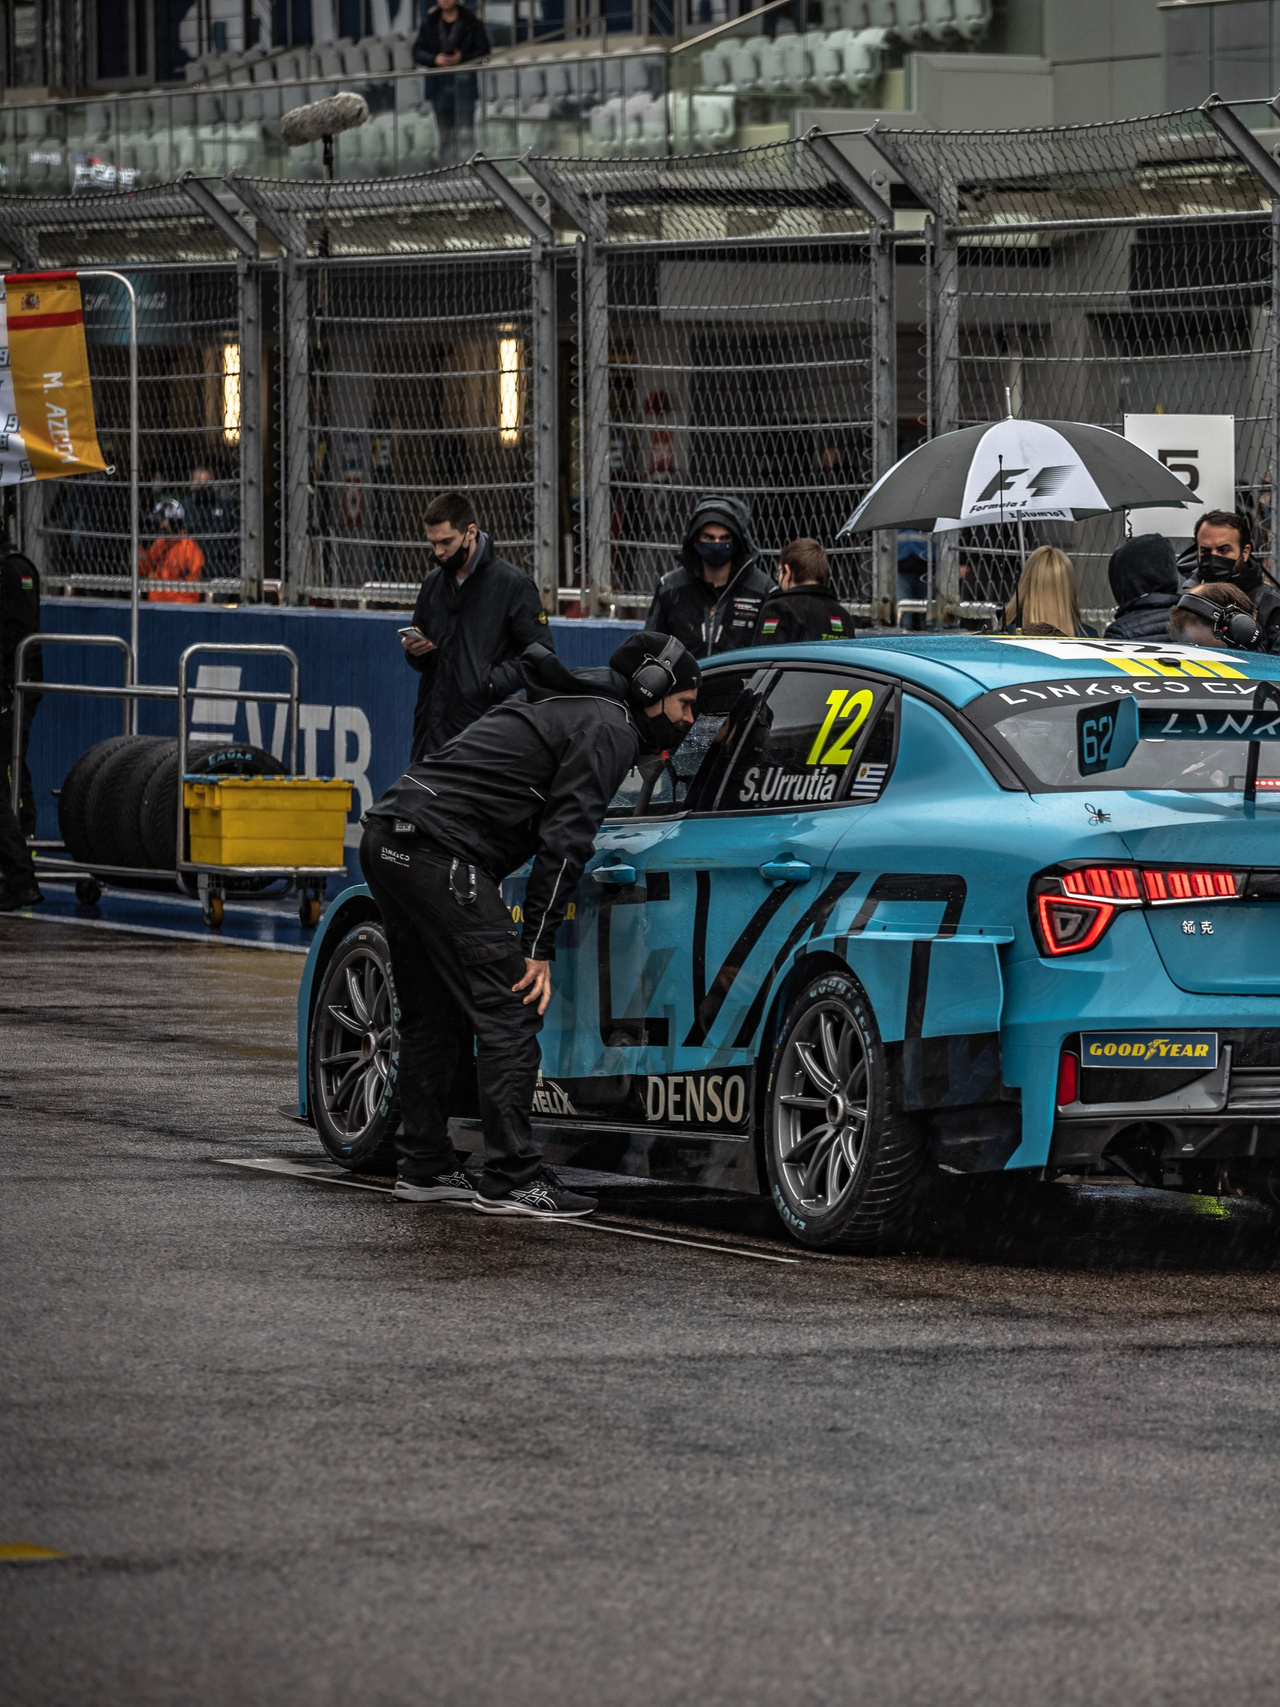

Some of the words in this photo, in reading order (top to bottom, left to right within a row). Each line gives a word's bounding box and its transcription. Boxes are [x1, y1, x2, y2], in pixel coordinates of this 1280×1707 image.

[42, 370, 64, 395] M.
[976, 464, 1079, 503] F1
[969, 501, 1018, 514] Formula
[1060, 642, 1185, 655] 12
[806, 689, 873, 765] 12
[1082, 715, 1113, 765] 62
[207, 750, 253, 767] EAGLE
[244, 699, 374, 849] VTB
[739, 765, 838, 802] S.Urrutia
[1181, 920, 1214, 934] 领克
[646, 1074, 746, 1123] DENSO
